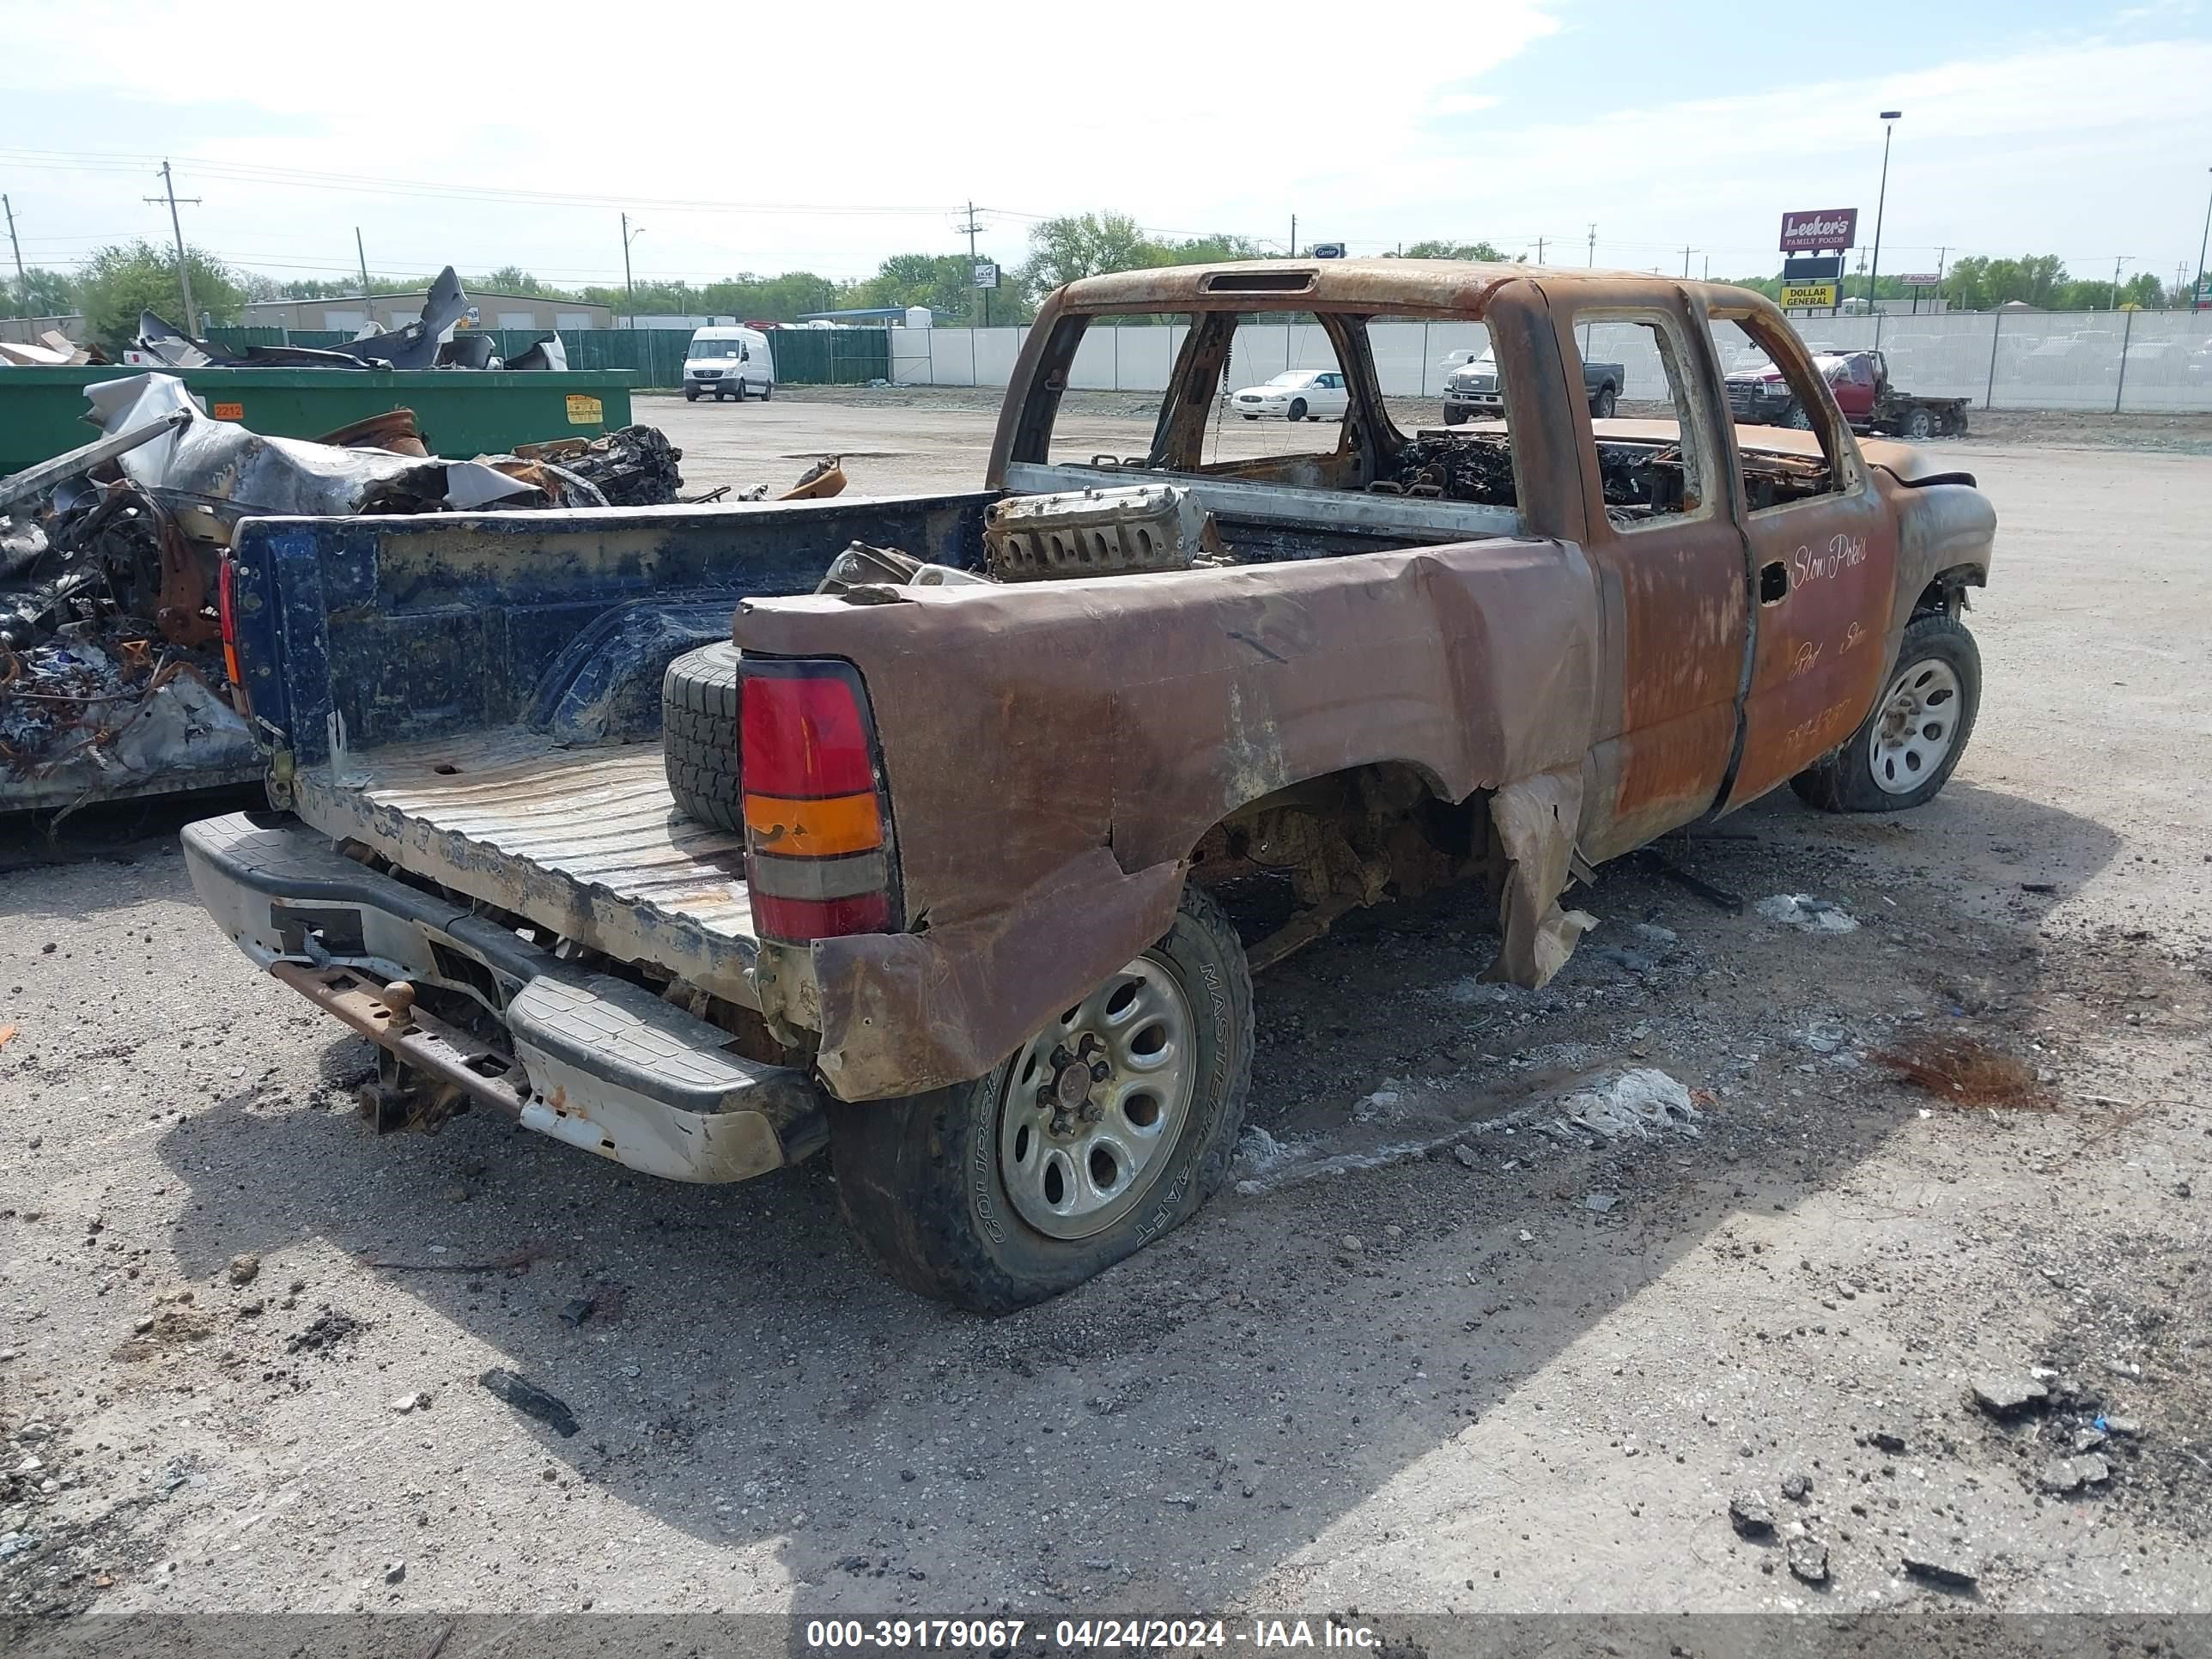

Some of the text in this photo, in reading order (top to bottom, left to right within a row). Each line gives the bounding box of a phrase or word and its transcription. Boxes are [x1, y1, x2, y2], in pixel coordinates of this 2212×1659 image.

[1785, 216, 1849, 237] Leeker's
[1790, 288, 1826, 297] DOLLAR
[1787, 297, 1828, 306] GENERAL
[216, 405, 241, 416] 2212
[1792, 545, 1826, 590] Slow
